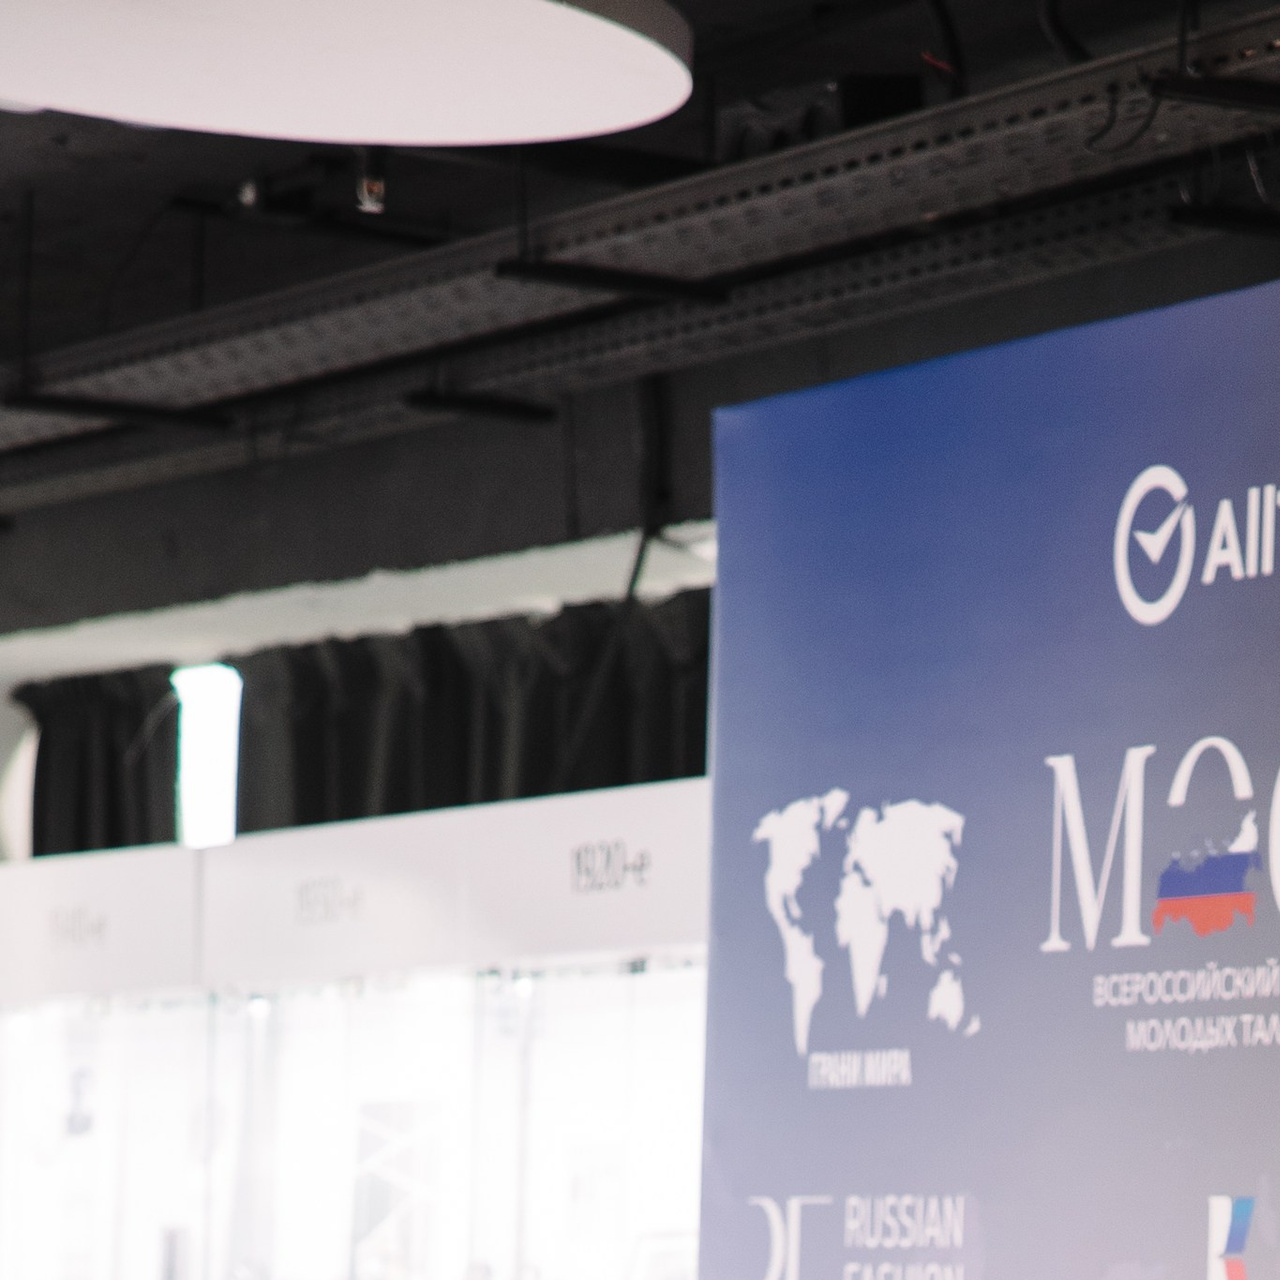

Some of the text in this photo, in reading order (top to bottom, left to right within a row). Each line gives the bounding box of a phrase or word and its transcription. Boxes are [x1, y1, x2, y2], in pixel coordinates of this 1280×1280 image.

[1093, 957, 1280, 1007] ВСЕРОССИЙСКИЙ
[1126, 1015, 1237, 1055] МОЛОДЫХ
[843, 1194, 965, 1249] RUSSIAN
